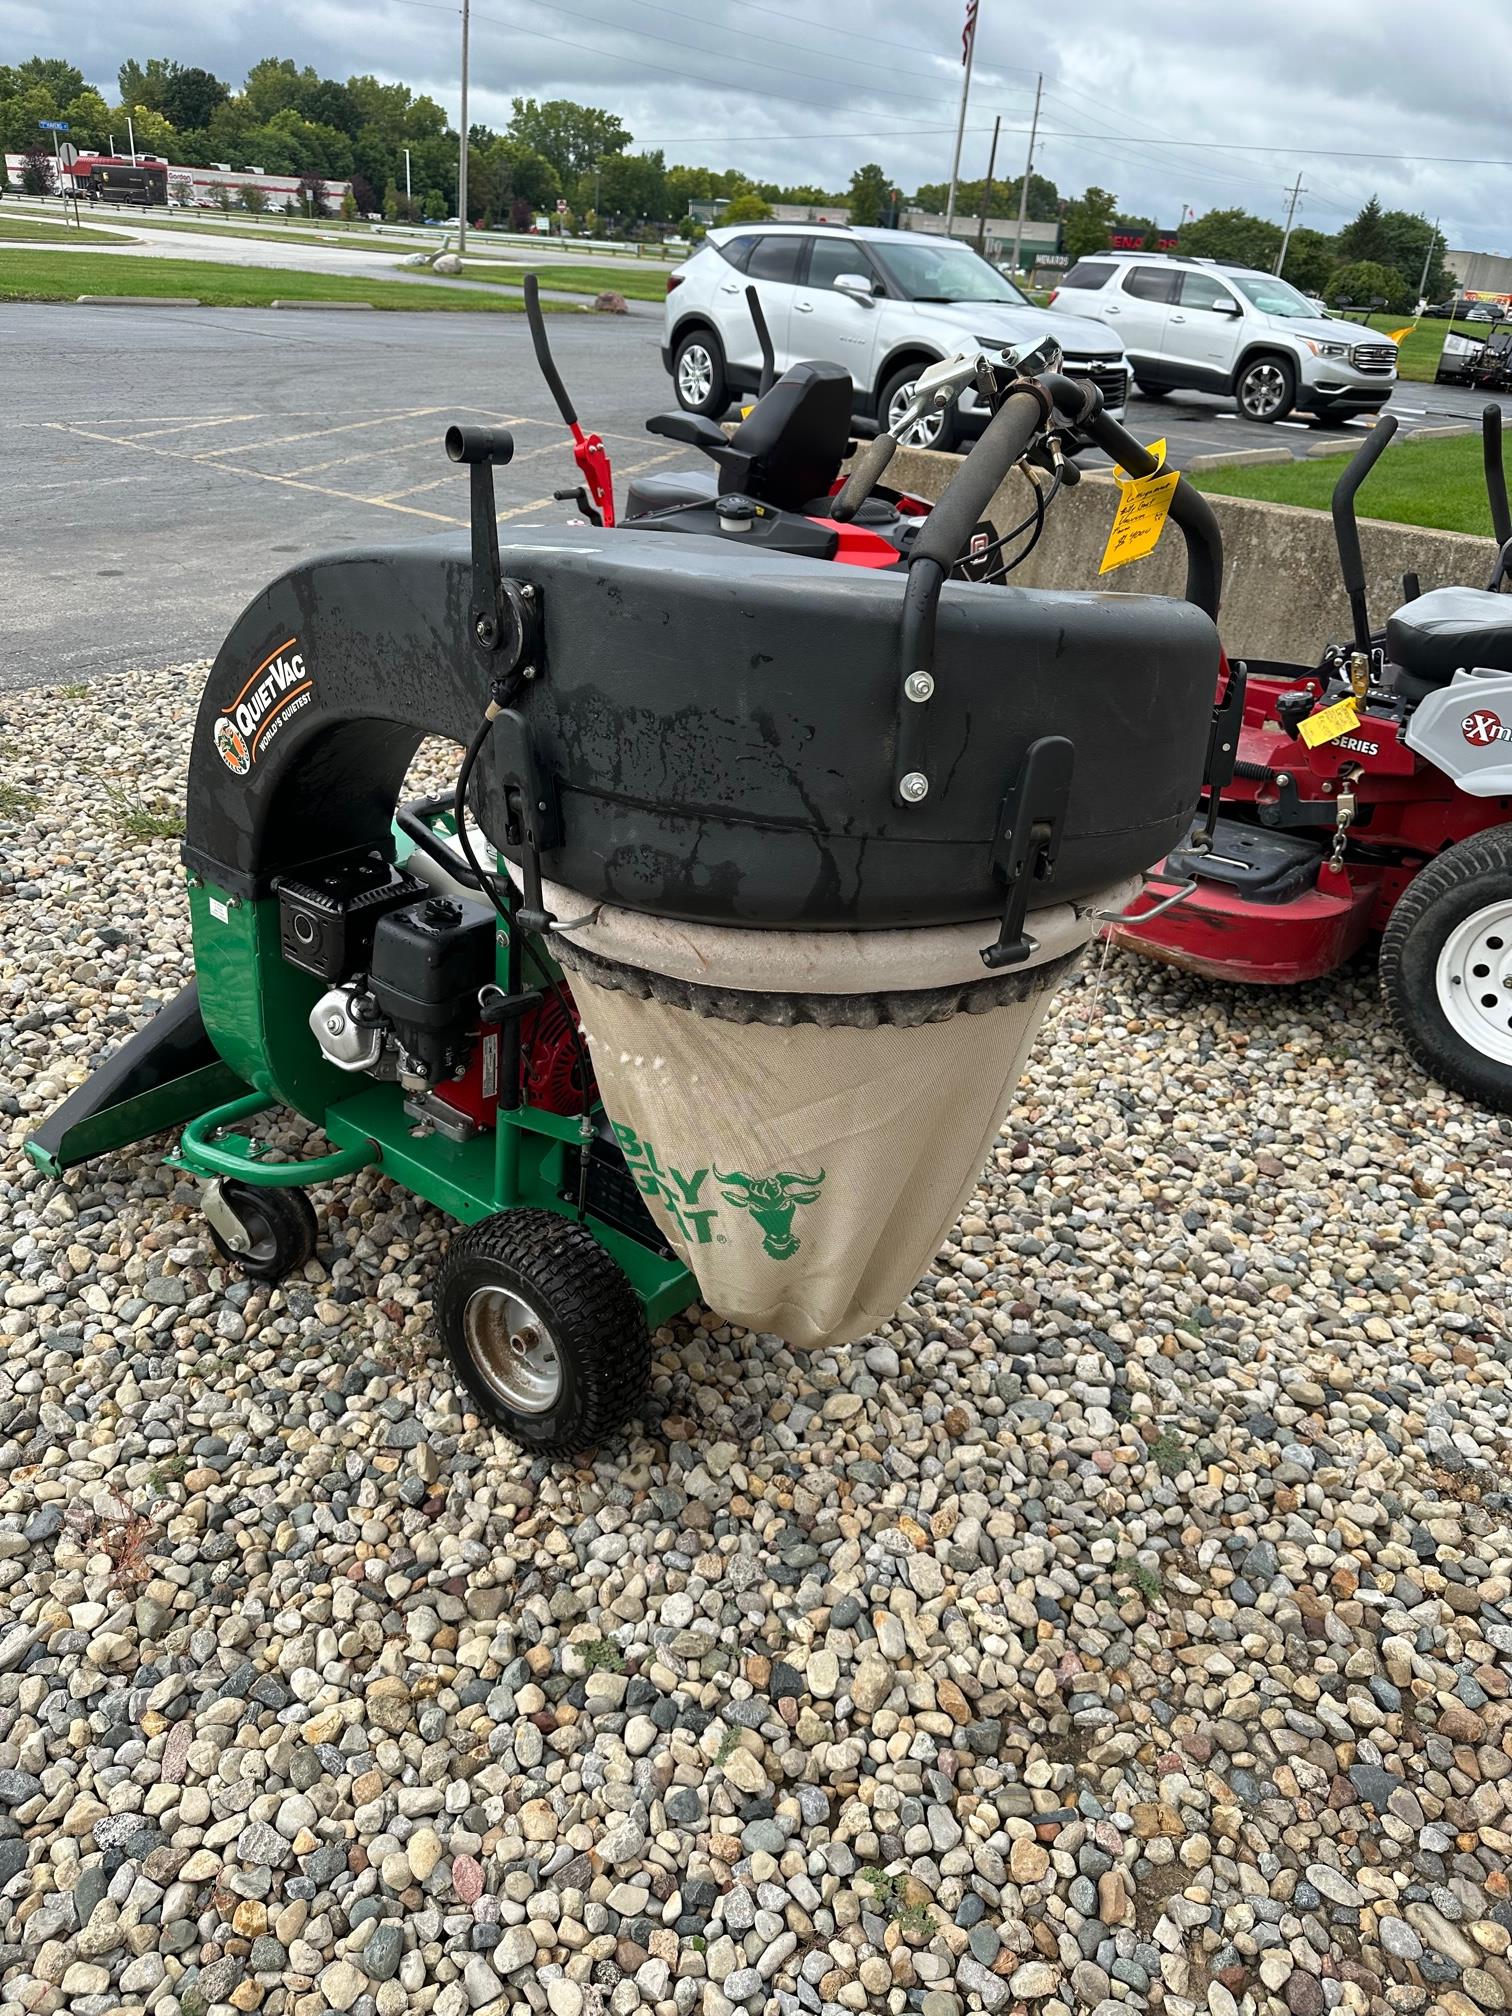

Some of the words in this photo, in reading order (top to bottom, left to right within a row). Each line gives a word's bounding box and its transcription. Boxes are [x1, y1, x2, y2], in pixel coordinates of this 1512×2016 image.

[259, 716, 282, 752] WORLD'S
[281, 691, 312, 721] QUIETEST
[1331, 736, 1379, 756] SERIES
